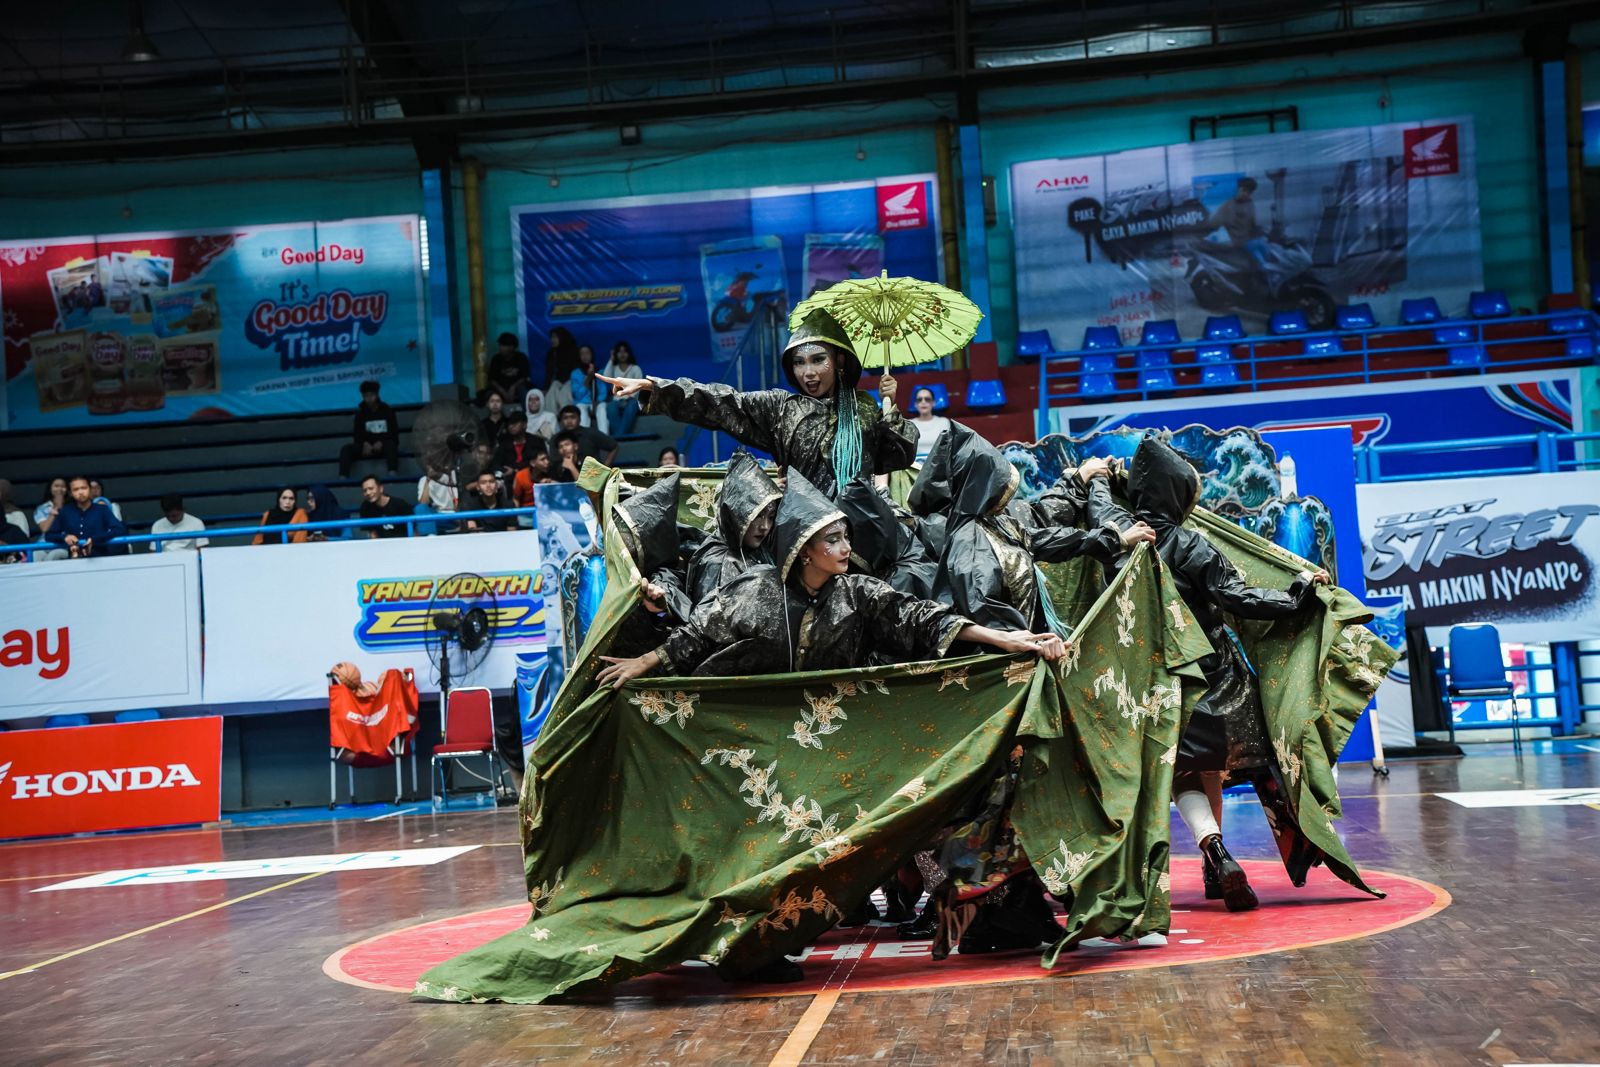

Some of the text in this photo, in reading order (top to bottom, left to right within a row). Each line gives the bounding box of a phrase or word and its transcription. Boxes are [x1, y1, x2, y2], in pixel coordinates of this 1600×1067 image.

[1036, 175, 1089, 188] AHM
[1073, 207, 1097, 223] PAKE
[1101, 226, 1127, 242] GAYA
[1127, 218, 1160, 237] MAKIN
[281, 246, 326, 266] Good
[329, 244, 365, 265] Day
[279, 278, 310, 302] It's
[253, 291, 386, 336] Good Day
[282, 321, 361, 360] Time!
[1363, 504, 1600, 581] STREET
[362, 580, 434, 604] YANG
[437, 575, 532, 599] WORTH
[1419, 573, 1488, 609] MAKIN
[11, 763, 201, 800] HONDA
